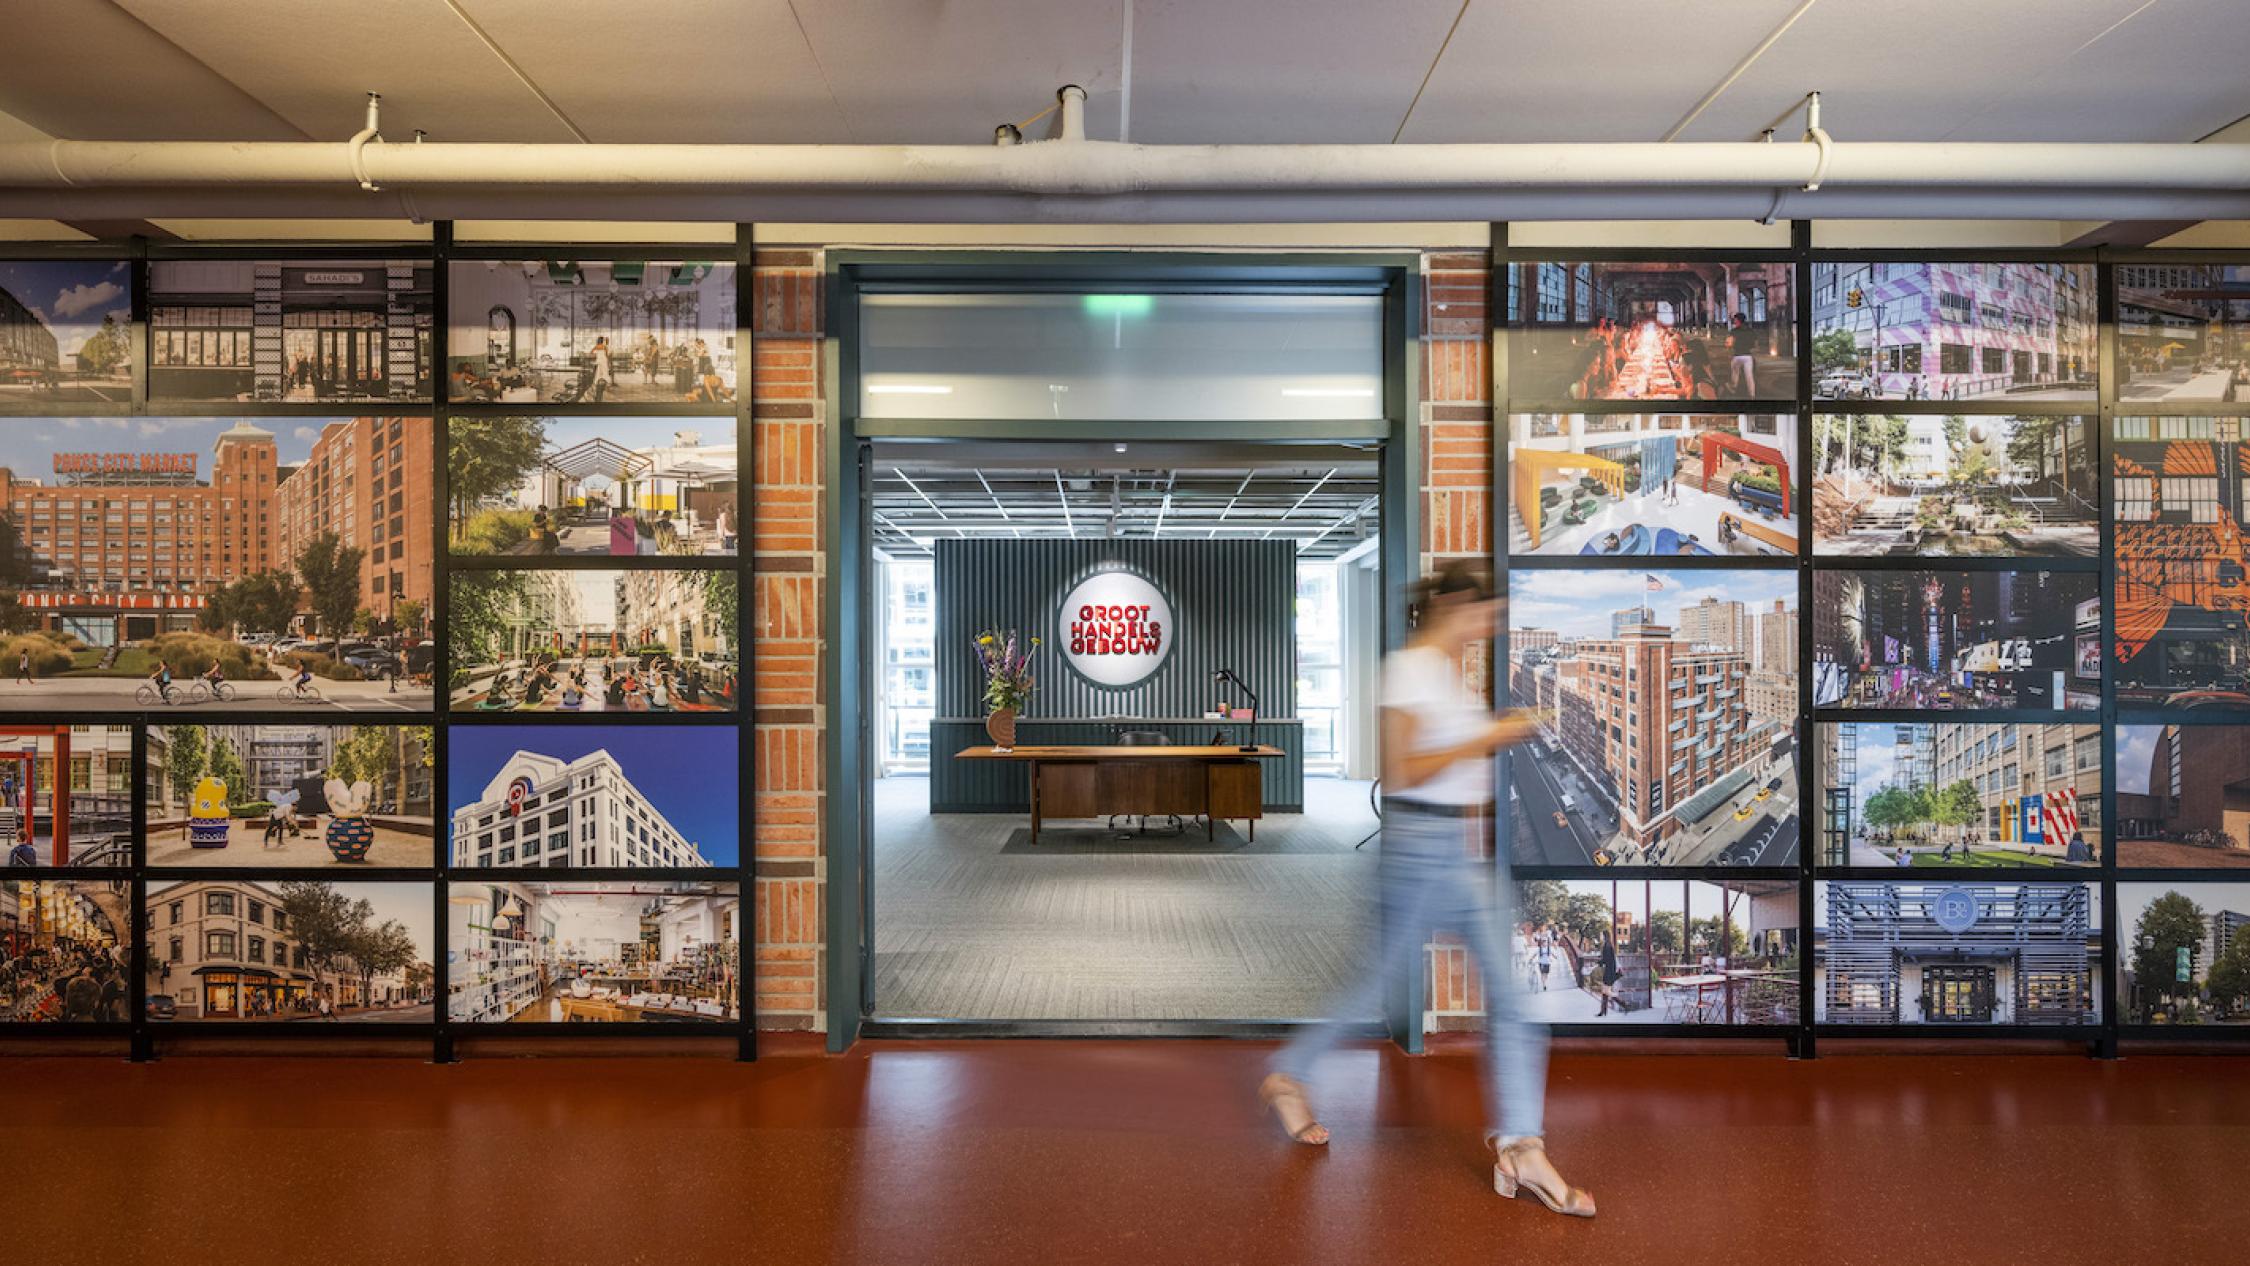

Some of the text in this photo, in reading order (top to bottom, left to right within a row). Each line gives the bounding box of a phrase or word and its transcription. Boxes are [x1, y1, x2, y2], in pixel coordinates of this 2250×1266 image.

[53, 453, 198, 473] PONCE CITY MARKET
[153, 594, 207, 608] MARK
[1079, 605, 1151, 621] GROOT
[1070, 621, 1161, 638] HANDELS
[1070, 638, 1161, 655] GEBOUW
